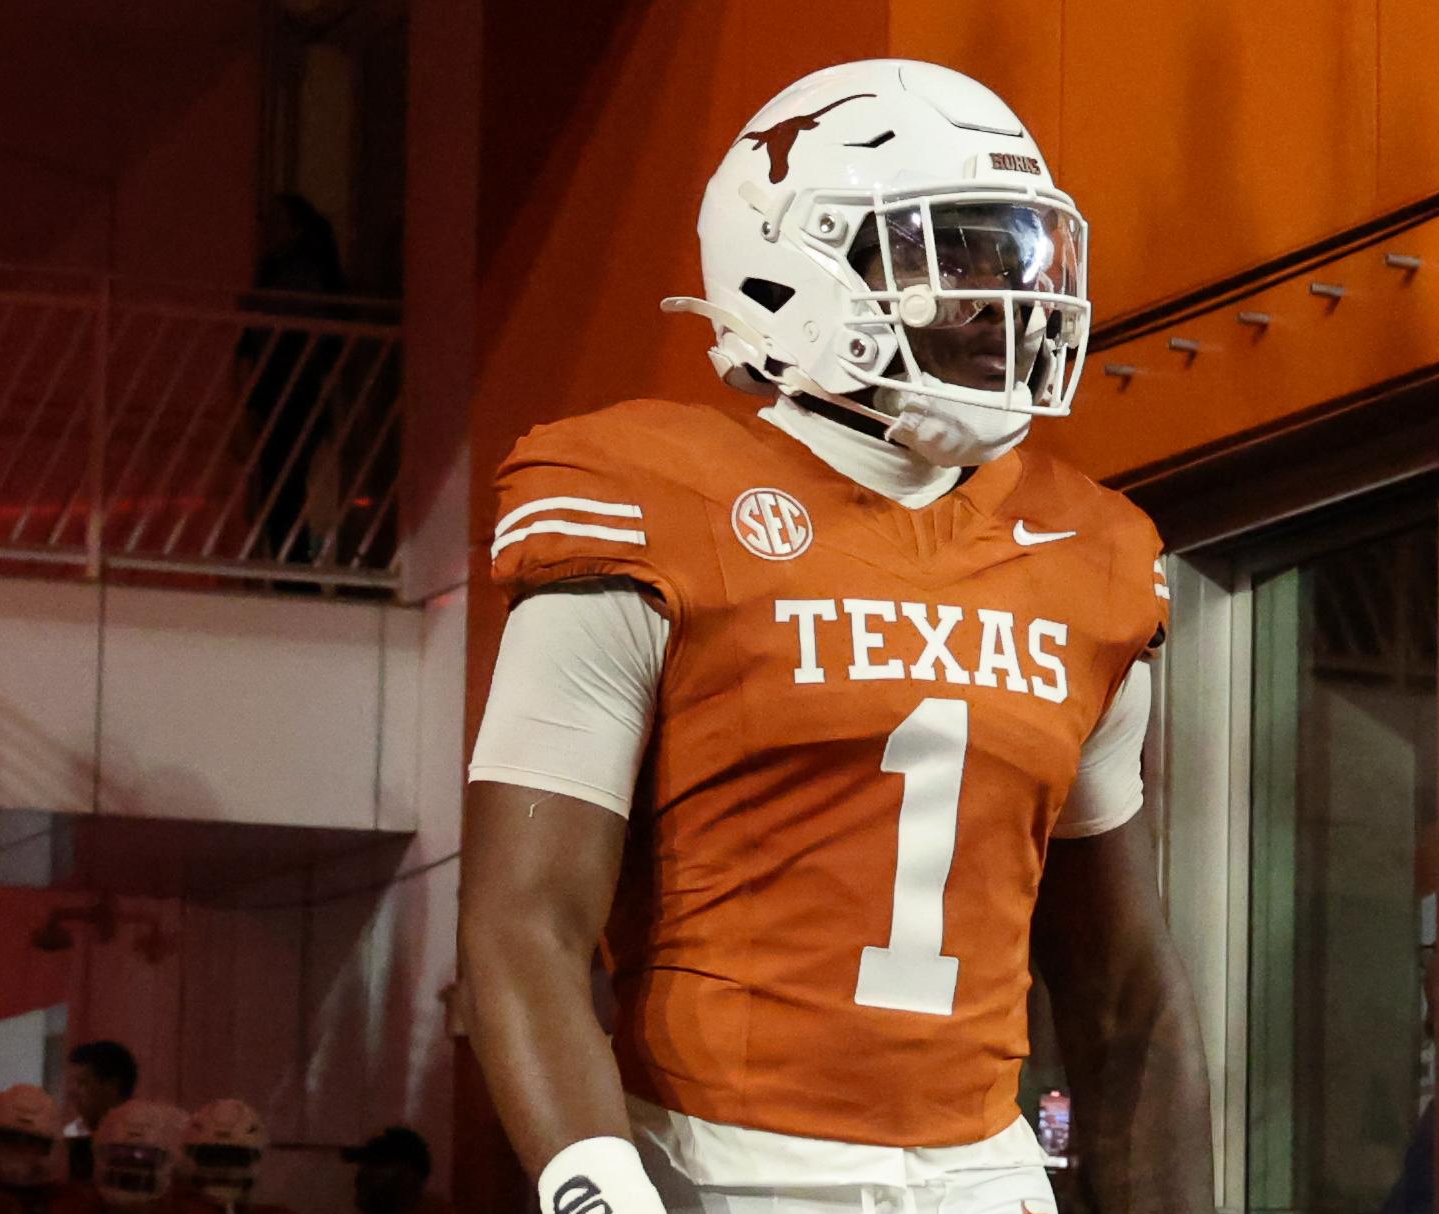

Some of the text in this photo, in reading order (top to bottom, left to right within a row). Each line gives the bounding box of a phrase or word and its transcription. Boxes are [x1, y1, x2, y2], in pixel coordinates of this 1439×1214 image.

[738, 492, 809, 556] SEC
[774, 598, 1069, 703] TEXAS
[854, 697, 968, 1015] 1
